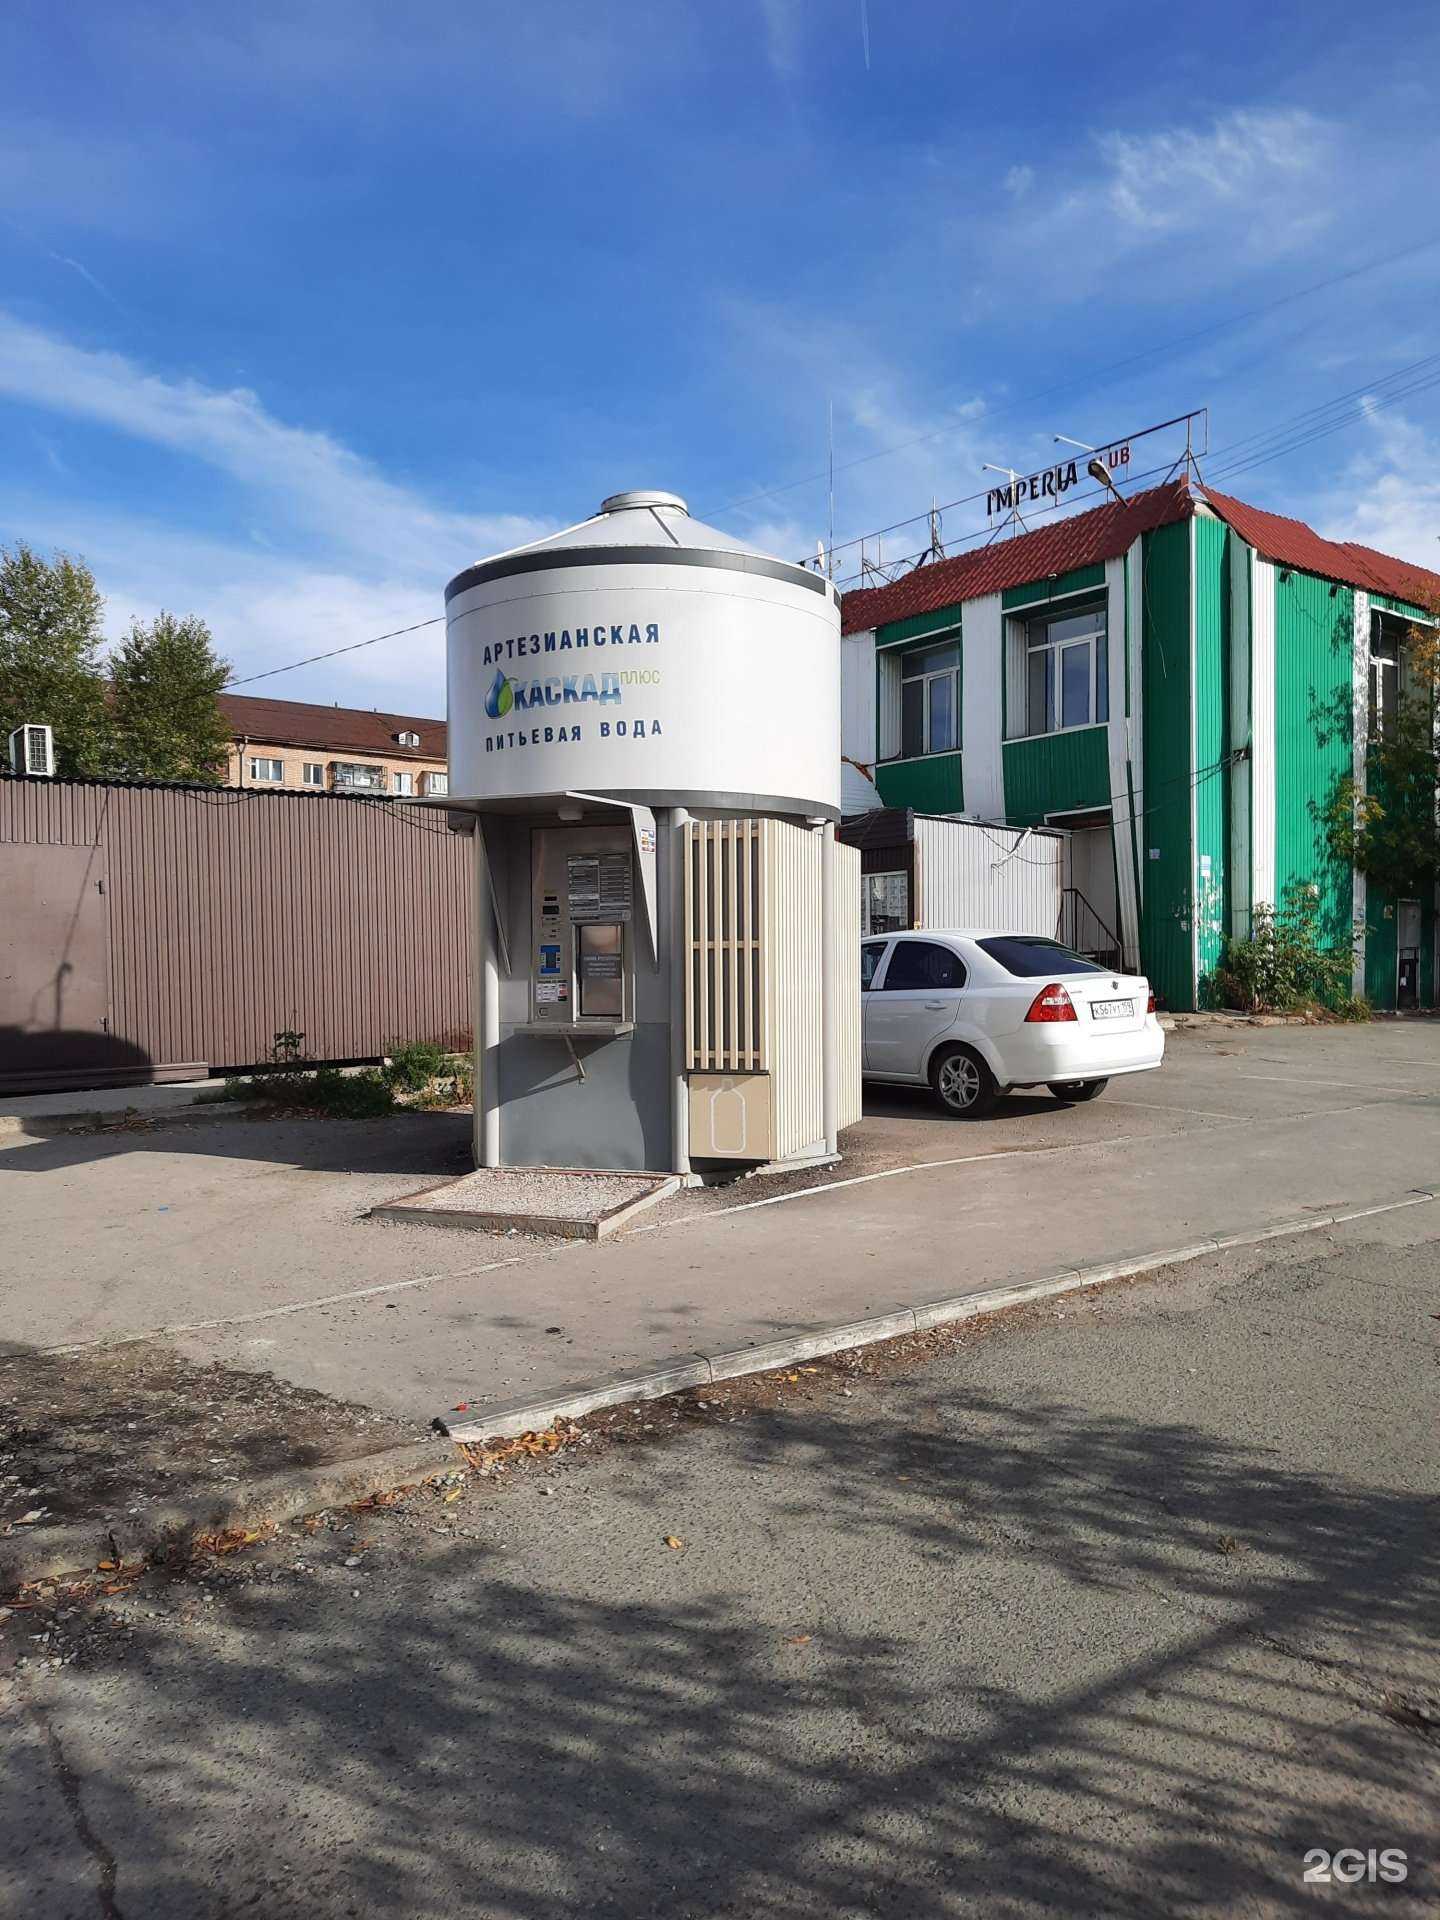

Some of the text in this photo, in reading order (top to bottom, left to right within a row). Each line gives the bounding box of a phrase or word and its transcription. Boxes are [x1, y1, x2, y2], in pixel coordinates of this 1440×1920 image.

[483, 623, 659, 665] АРТЕЗИАНСКАЯ
[514, 670, 660, 711] КАСКАД ПЛЮС
[485, 720, 662, 752] ПИТЬЕВАЯ ВОДА
